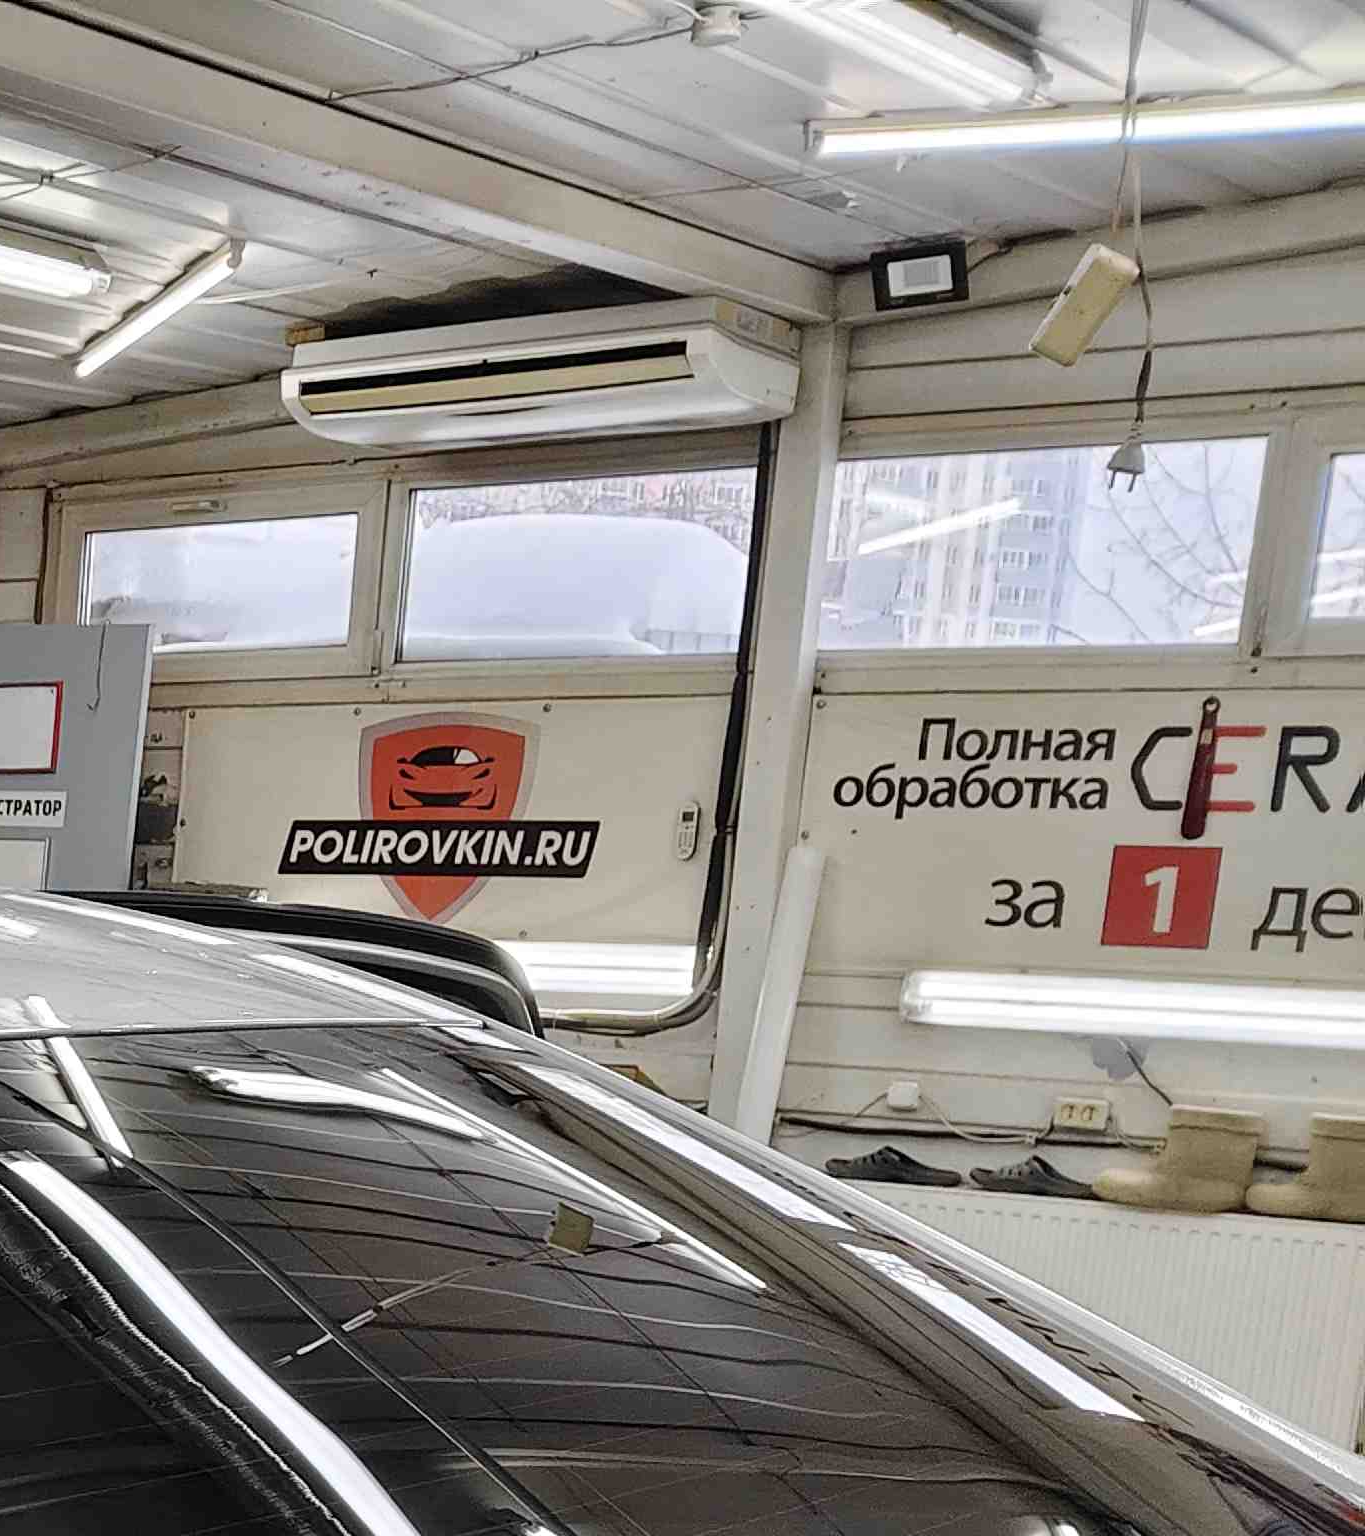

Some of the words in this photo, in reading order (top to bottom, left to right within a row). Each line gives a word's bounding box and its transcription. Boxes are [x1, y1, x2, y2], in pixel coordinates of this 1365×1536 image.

[917, 717, 1117, 762] Полная
[832, 763, 1109, 820] обработка
[289, 829, 591, 866] POLIROVKIN.RU
[984, 878, 1067, 929] за
[1143, 866, 1180, 934] 1
[1250, 885, 1365, 953] де
